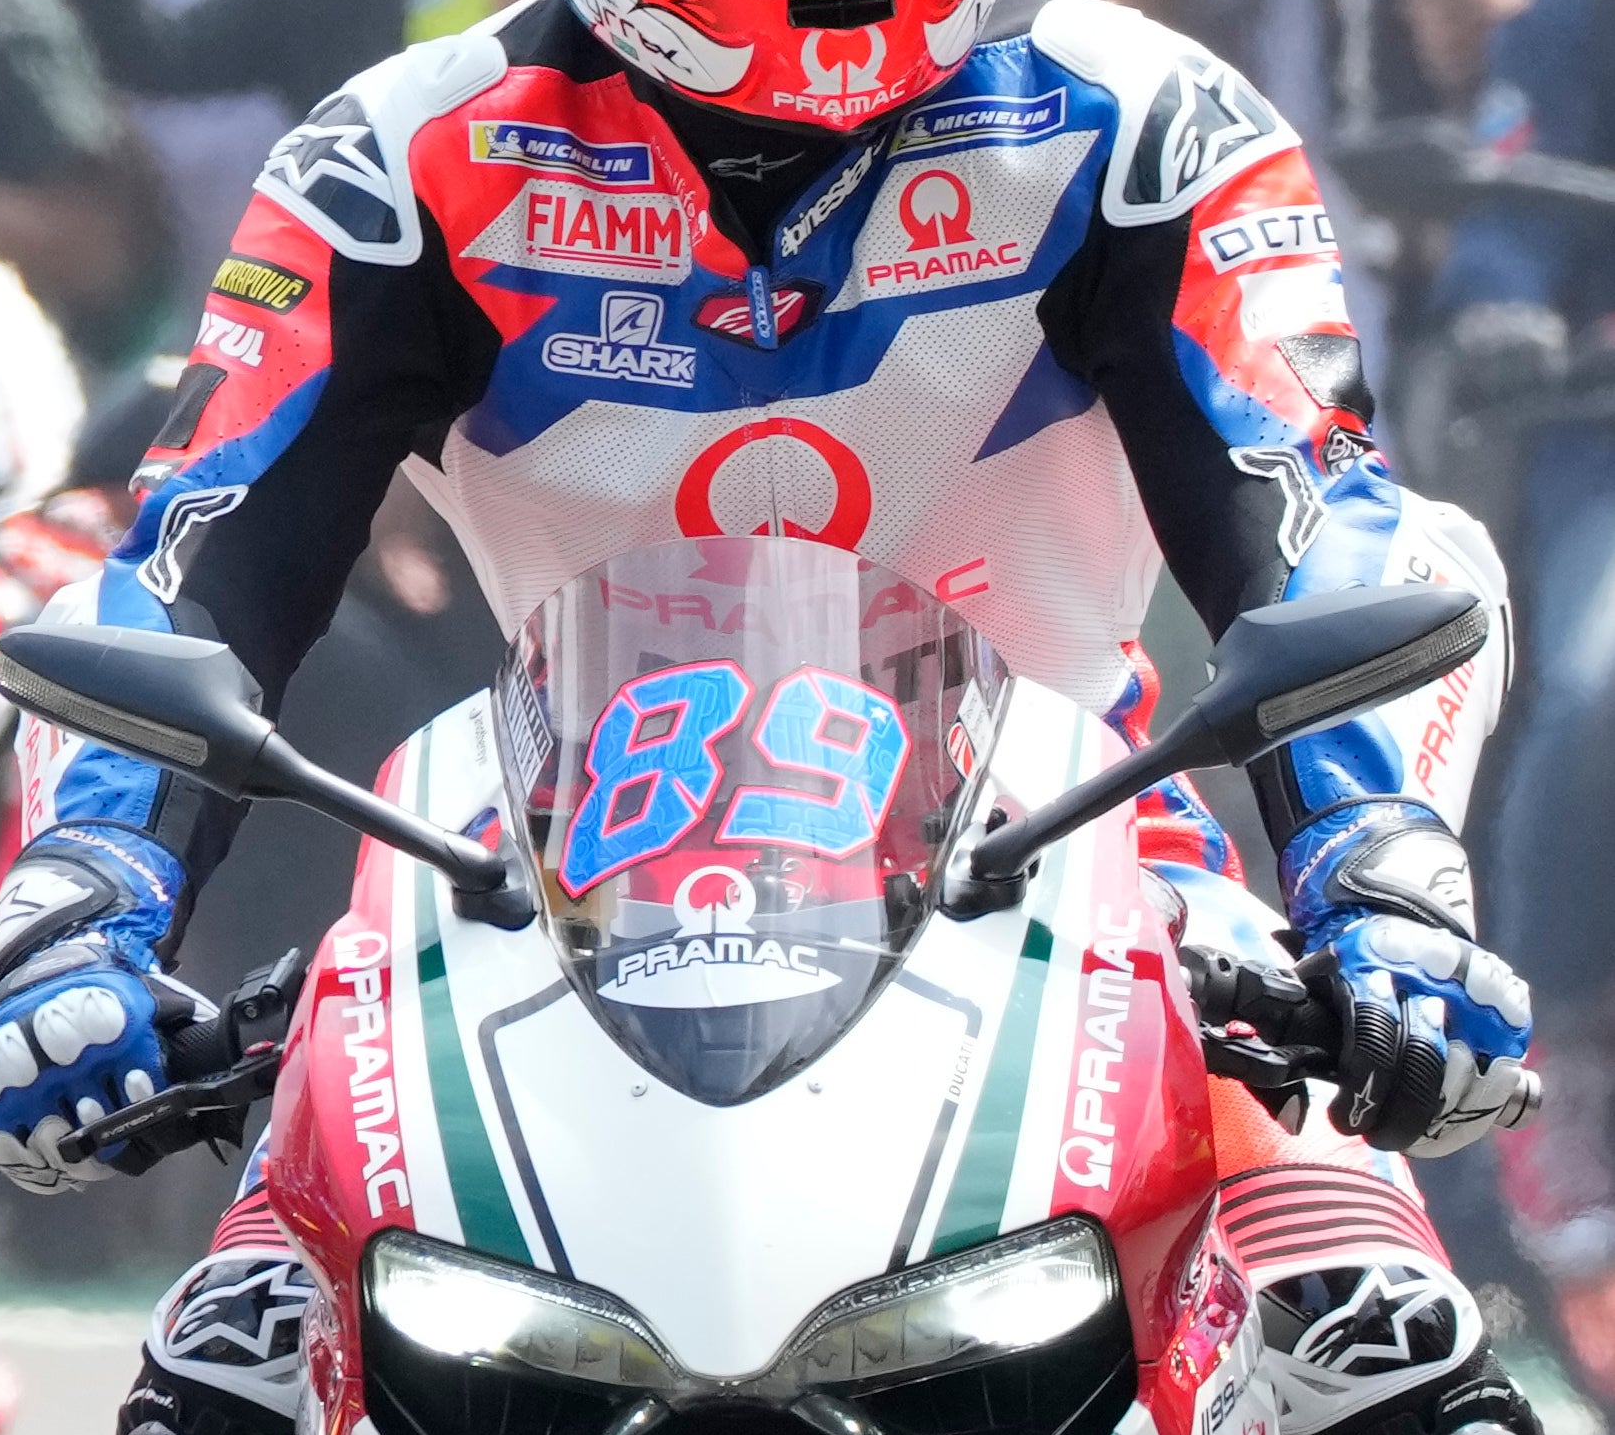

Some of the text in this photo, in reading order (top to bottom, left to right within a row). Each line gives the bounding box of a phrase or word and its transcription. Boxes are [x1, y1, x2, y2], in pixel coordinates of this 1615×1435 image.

[772, 77, 907, 117] PRAMAC
[933, 107, 1051, 136] MICHELIN
[526, 138, 633, 173] MICHELIN
[526, 201, 682, 258] FIAMM
[867, 243, 1021, 287] PRAMAC
[548, 342, 695, 381] SHARK
[559, 659, 909, 899] 89
[617, 934, 822, 986] PRAMAC
[1073, 904, 1141, 1128] PRAMAC
[948, 1037, 979, 1098] DUCATI
[340, 975, 409, 1219] PRAMAC
